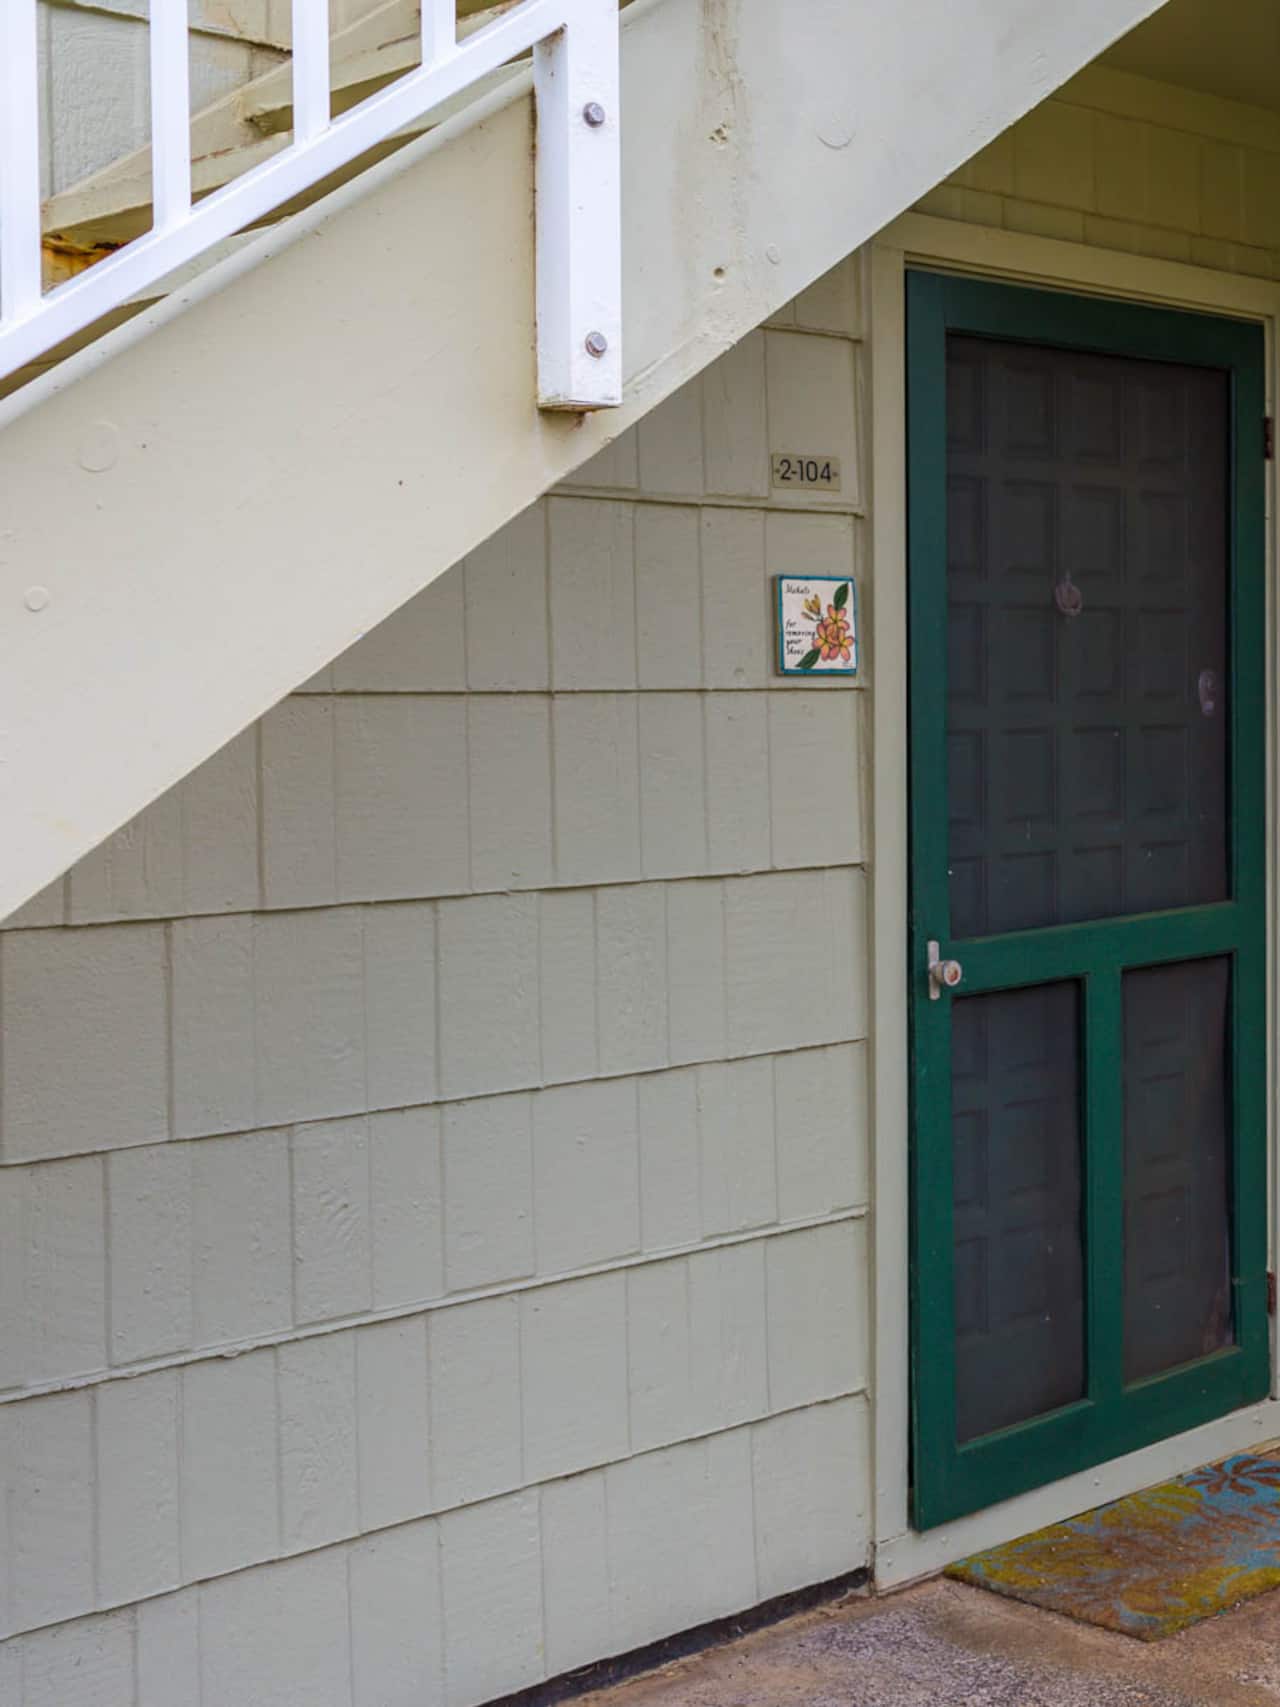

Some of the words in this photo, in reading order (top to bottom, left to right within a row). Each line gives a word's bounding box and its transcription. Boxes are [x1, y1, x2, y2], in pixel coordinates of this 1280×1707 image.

[779, 459, 831, 482] 2-104
[785, 631, 816, 641] removing
[786, 639, 802, 649] your
